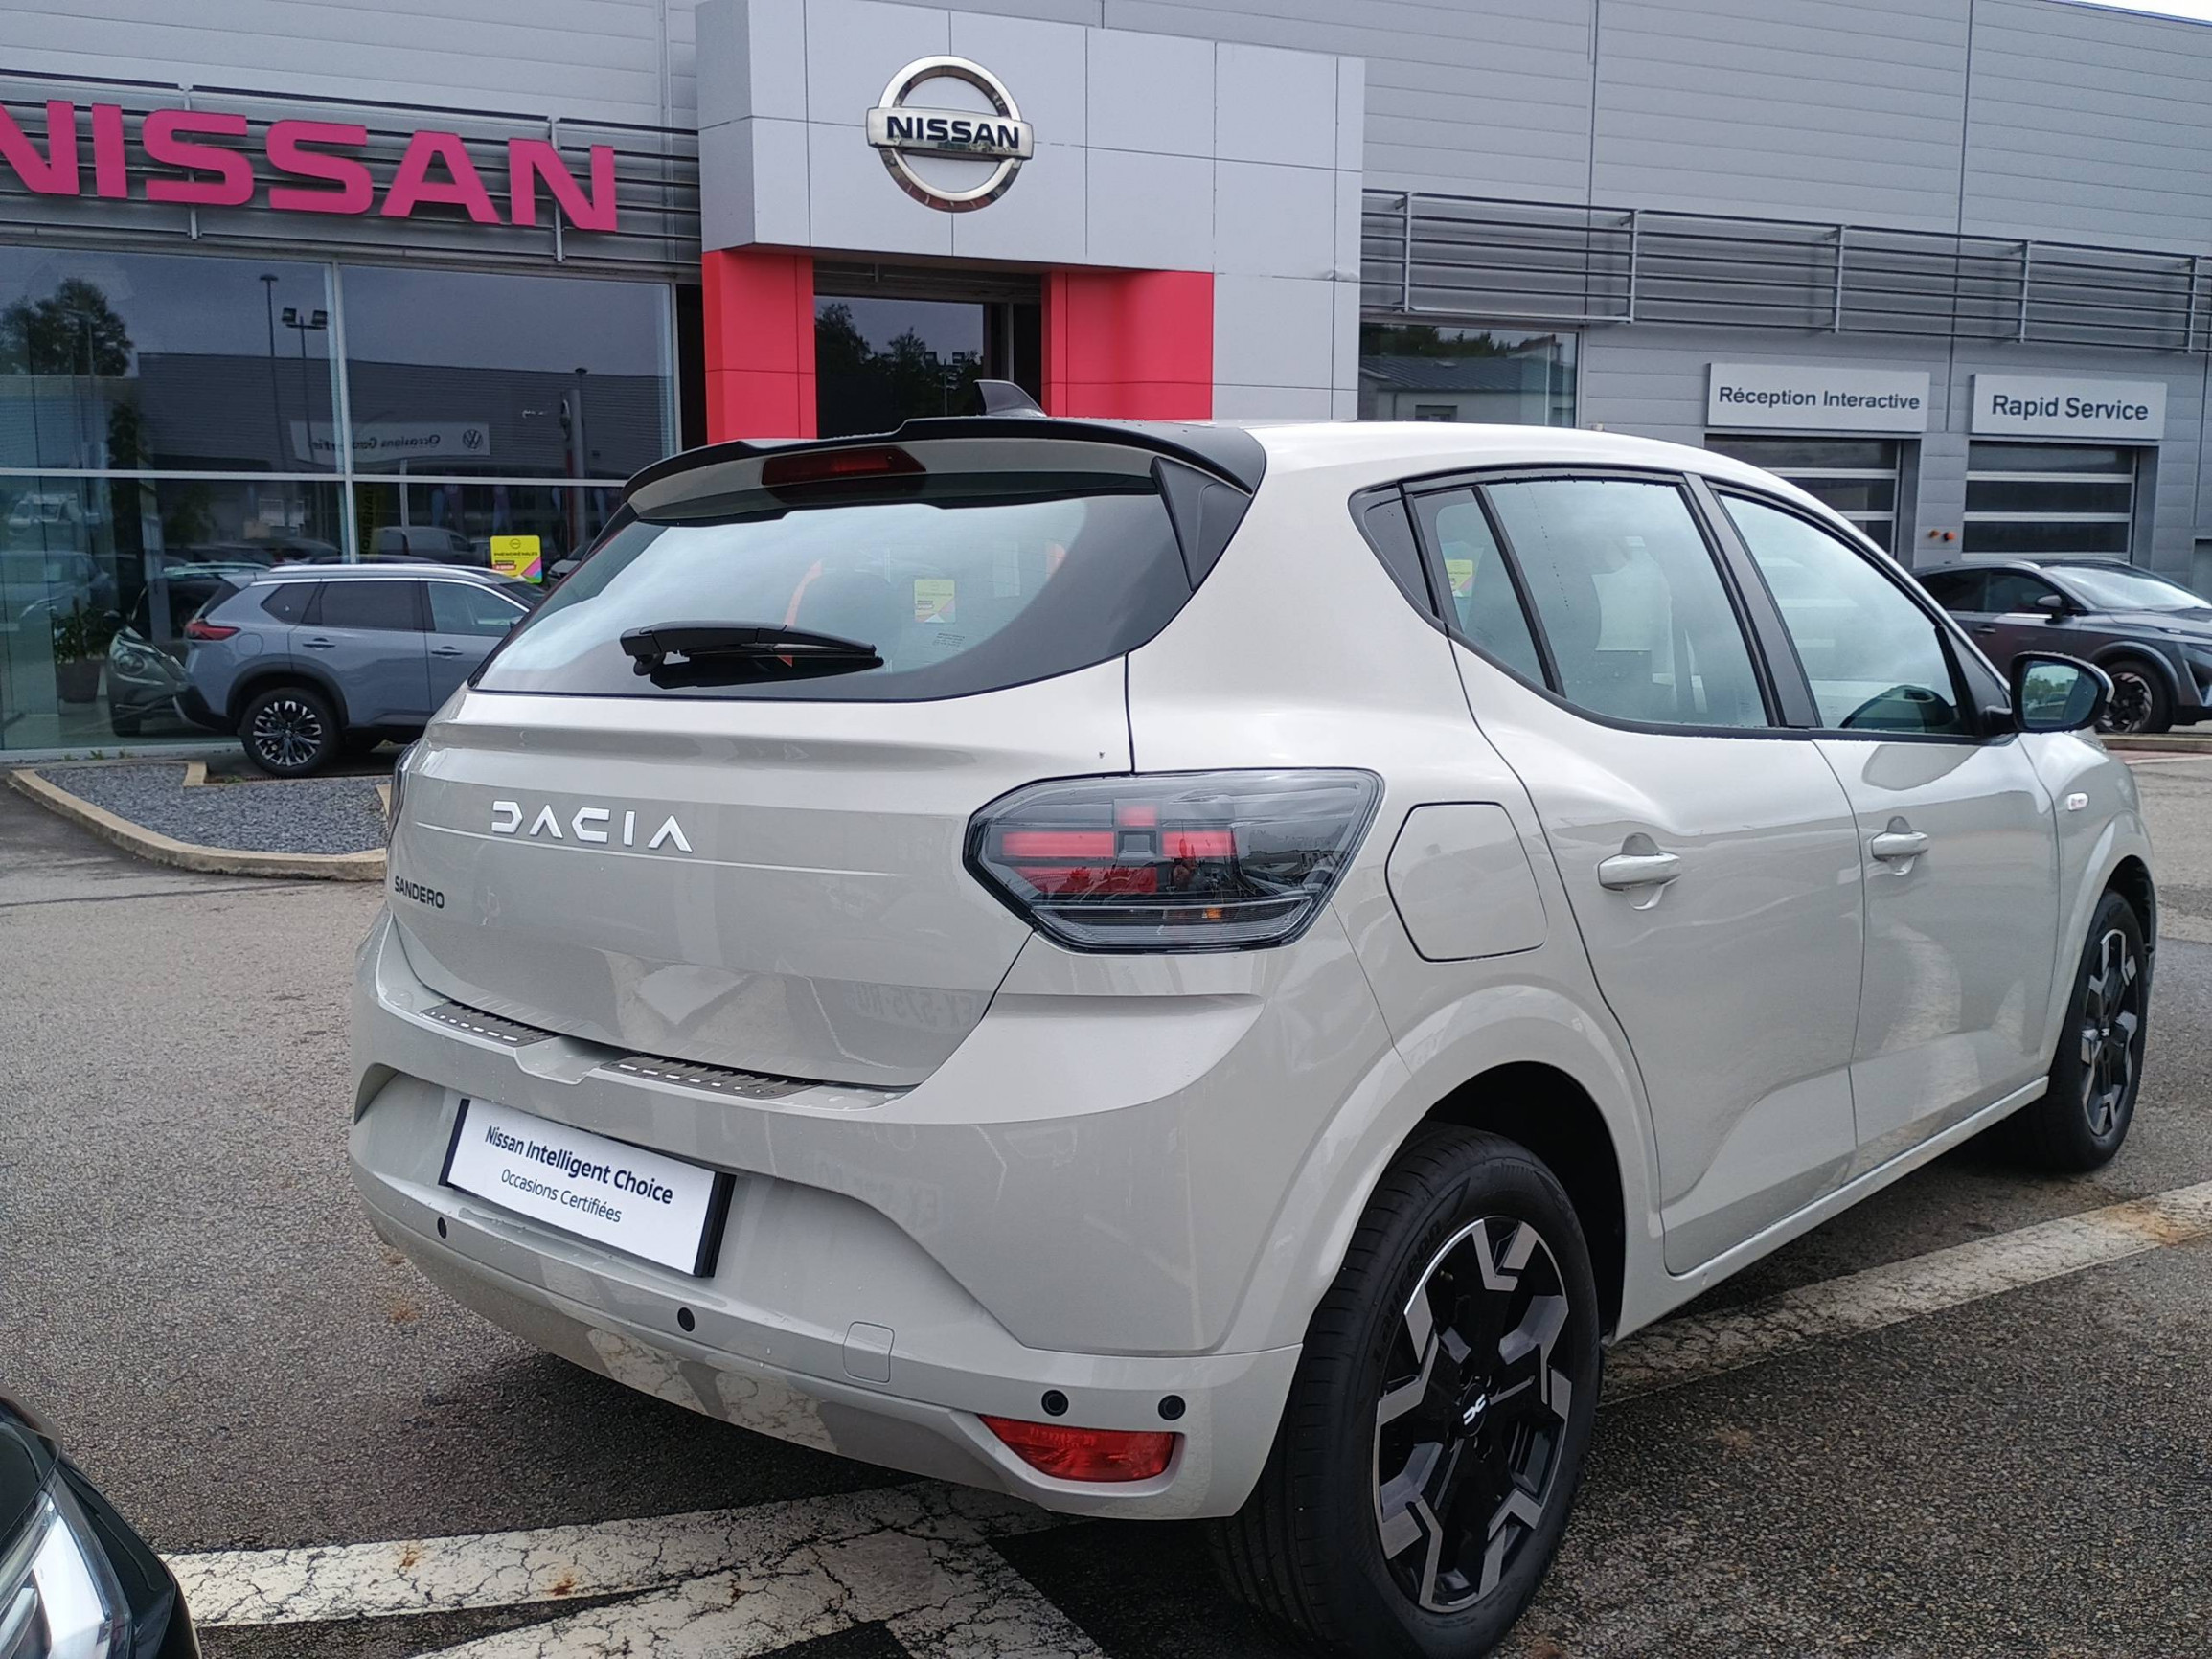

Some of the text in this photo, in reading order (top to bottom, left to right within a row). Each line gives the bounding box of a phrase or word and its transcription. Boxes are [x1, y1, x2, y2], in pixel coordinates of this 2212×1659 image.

[886, 115, 1020, 149] NISSAN
[0, 100, 617, 231] NISSAN
[1719, 386, 1920, 411] Réception Interactive
[1992, 394, 2149, 421] Rapid Service
[490, 800, 694, 852] DACIA
[394, 875, 445, 909] SANDERO
[485, 1125, 673, 1204] Nissan Intelligent Choice
[501, 1169, 623, 1223] Occasions Certifiées
